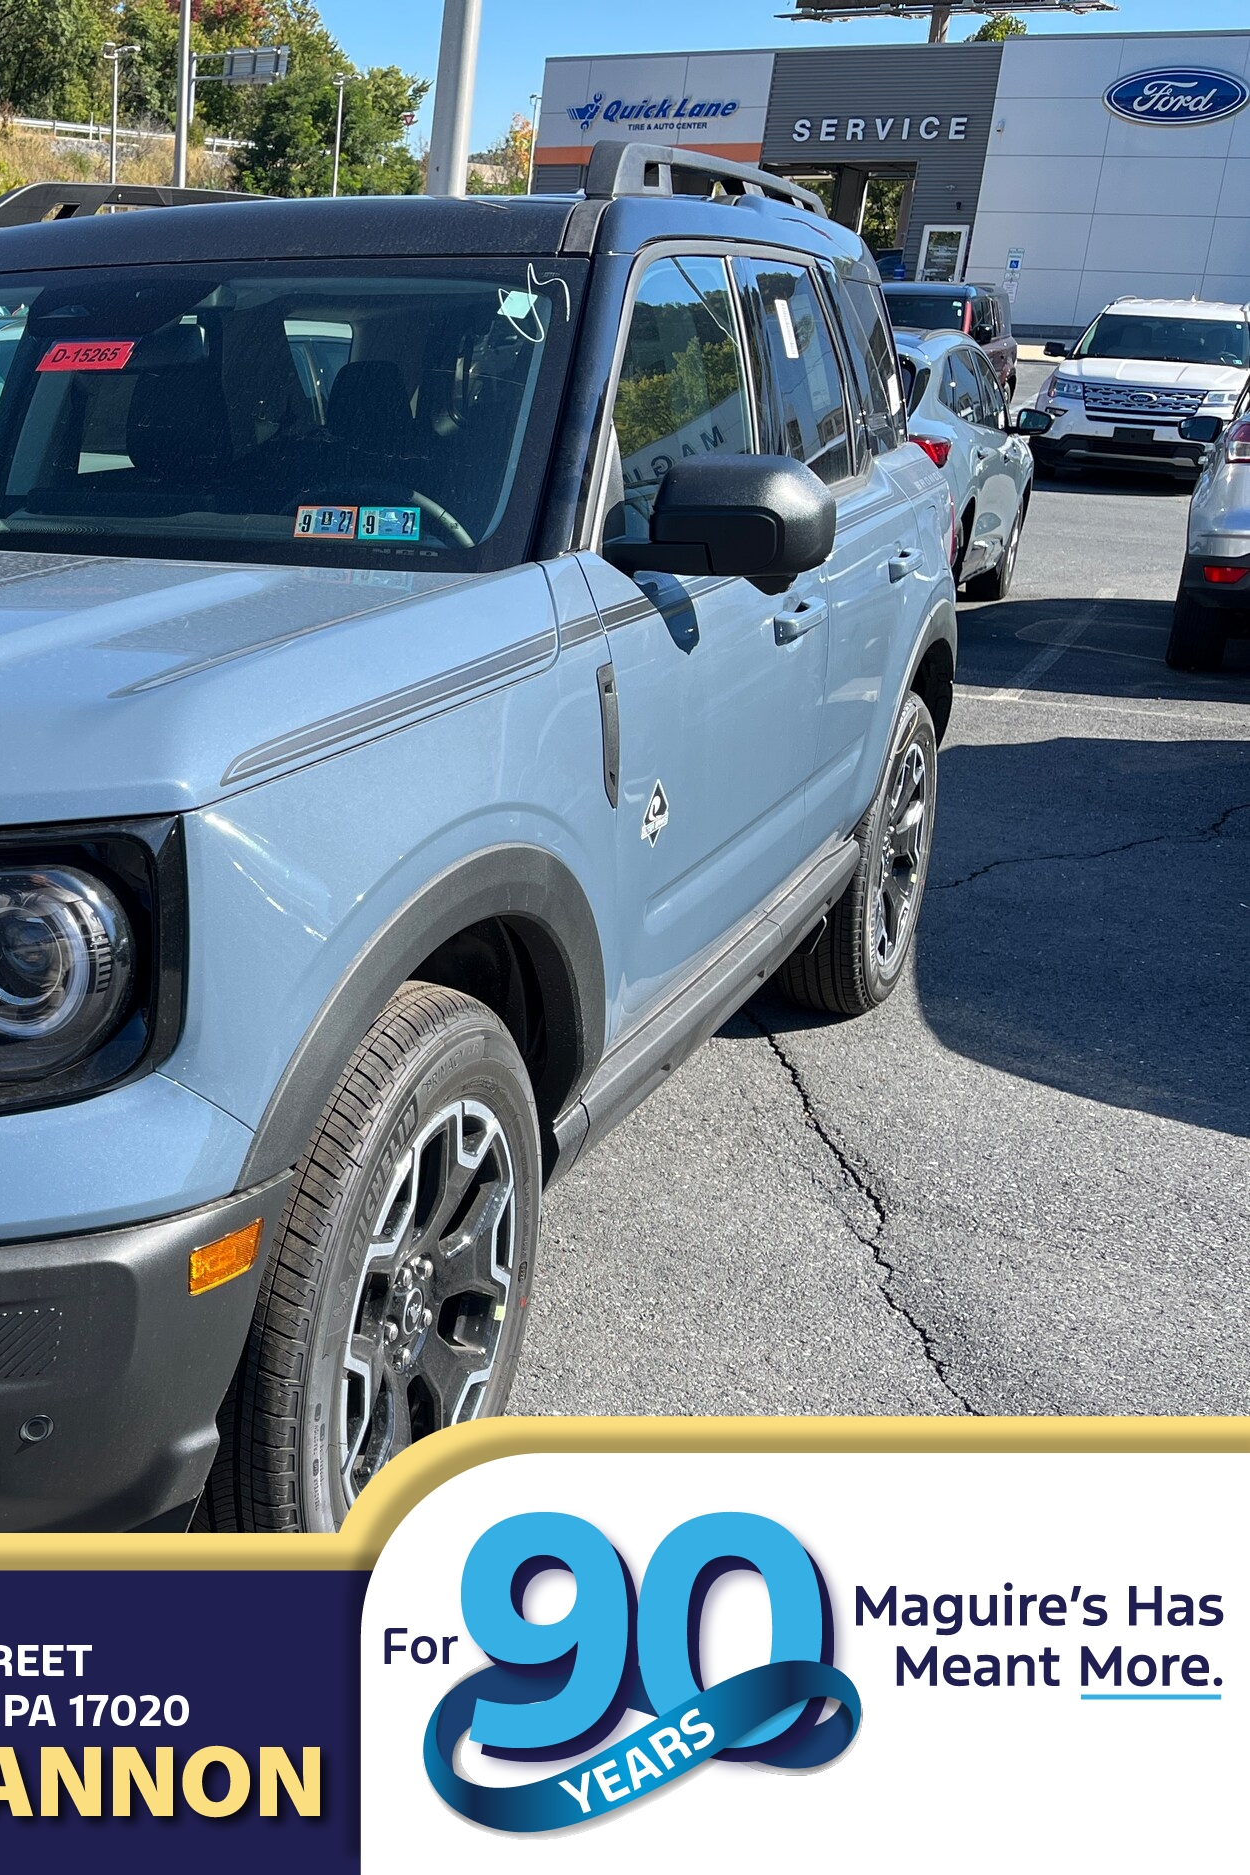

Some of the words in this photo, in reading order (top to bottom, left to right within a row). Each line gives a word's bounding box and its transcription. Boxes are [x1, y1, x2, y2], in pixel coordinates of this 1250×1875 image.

[1132, 80, 1218, 112] Ford
[602, 99, 672, 122] Quick
[673, 98, 738, 118] Lane
[628, 123, 645, 131] TIRE
[653, 122, 675, 130] AUTO
[676, 121, 708, 130] CENTER
[792, 116, 968, 142] SERVICE
[51, 347, 121, 363] D-15265
[301, 514, 312, 533] 9
[337, 511, 353, 534] 27
[365, 515, 375, 535] 9
[401, 511, 416, 534] 27
[348, 1103, 418, 1269] MICHELIN
